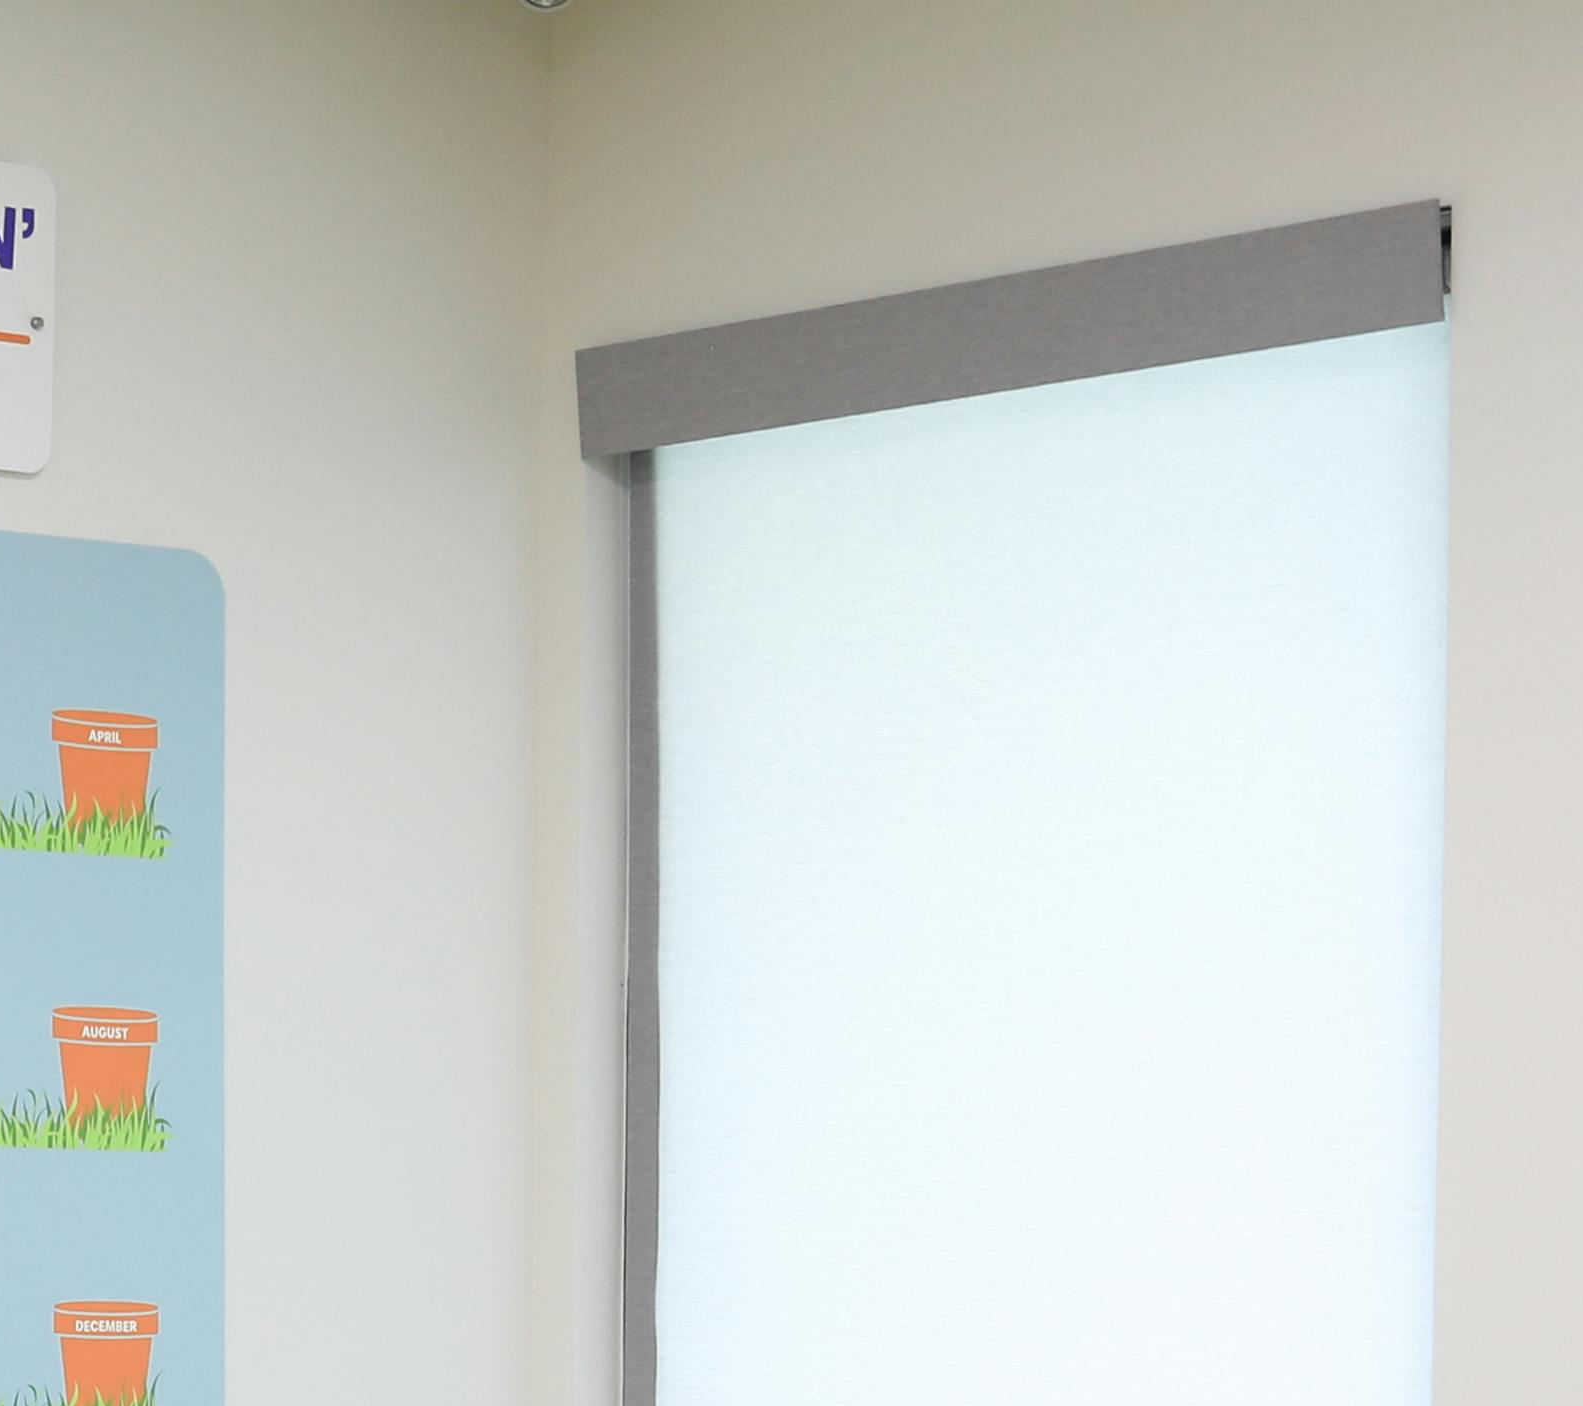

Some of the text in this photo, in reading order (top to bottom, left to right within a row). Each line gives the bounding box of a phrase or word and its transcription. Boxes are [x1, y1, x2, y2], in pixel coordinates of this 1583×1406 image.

[88, 729, 122, 745] APRIL
[81, 1025, 129, 1040] AUGUST
[75, 1319, 138, 1333] DECEMBER
